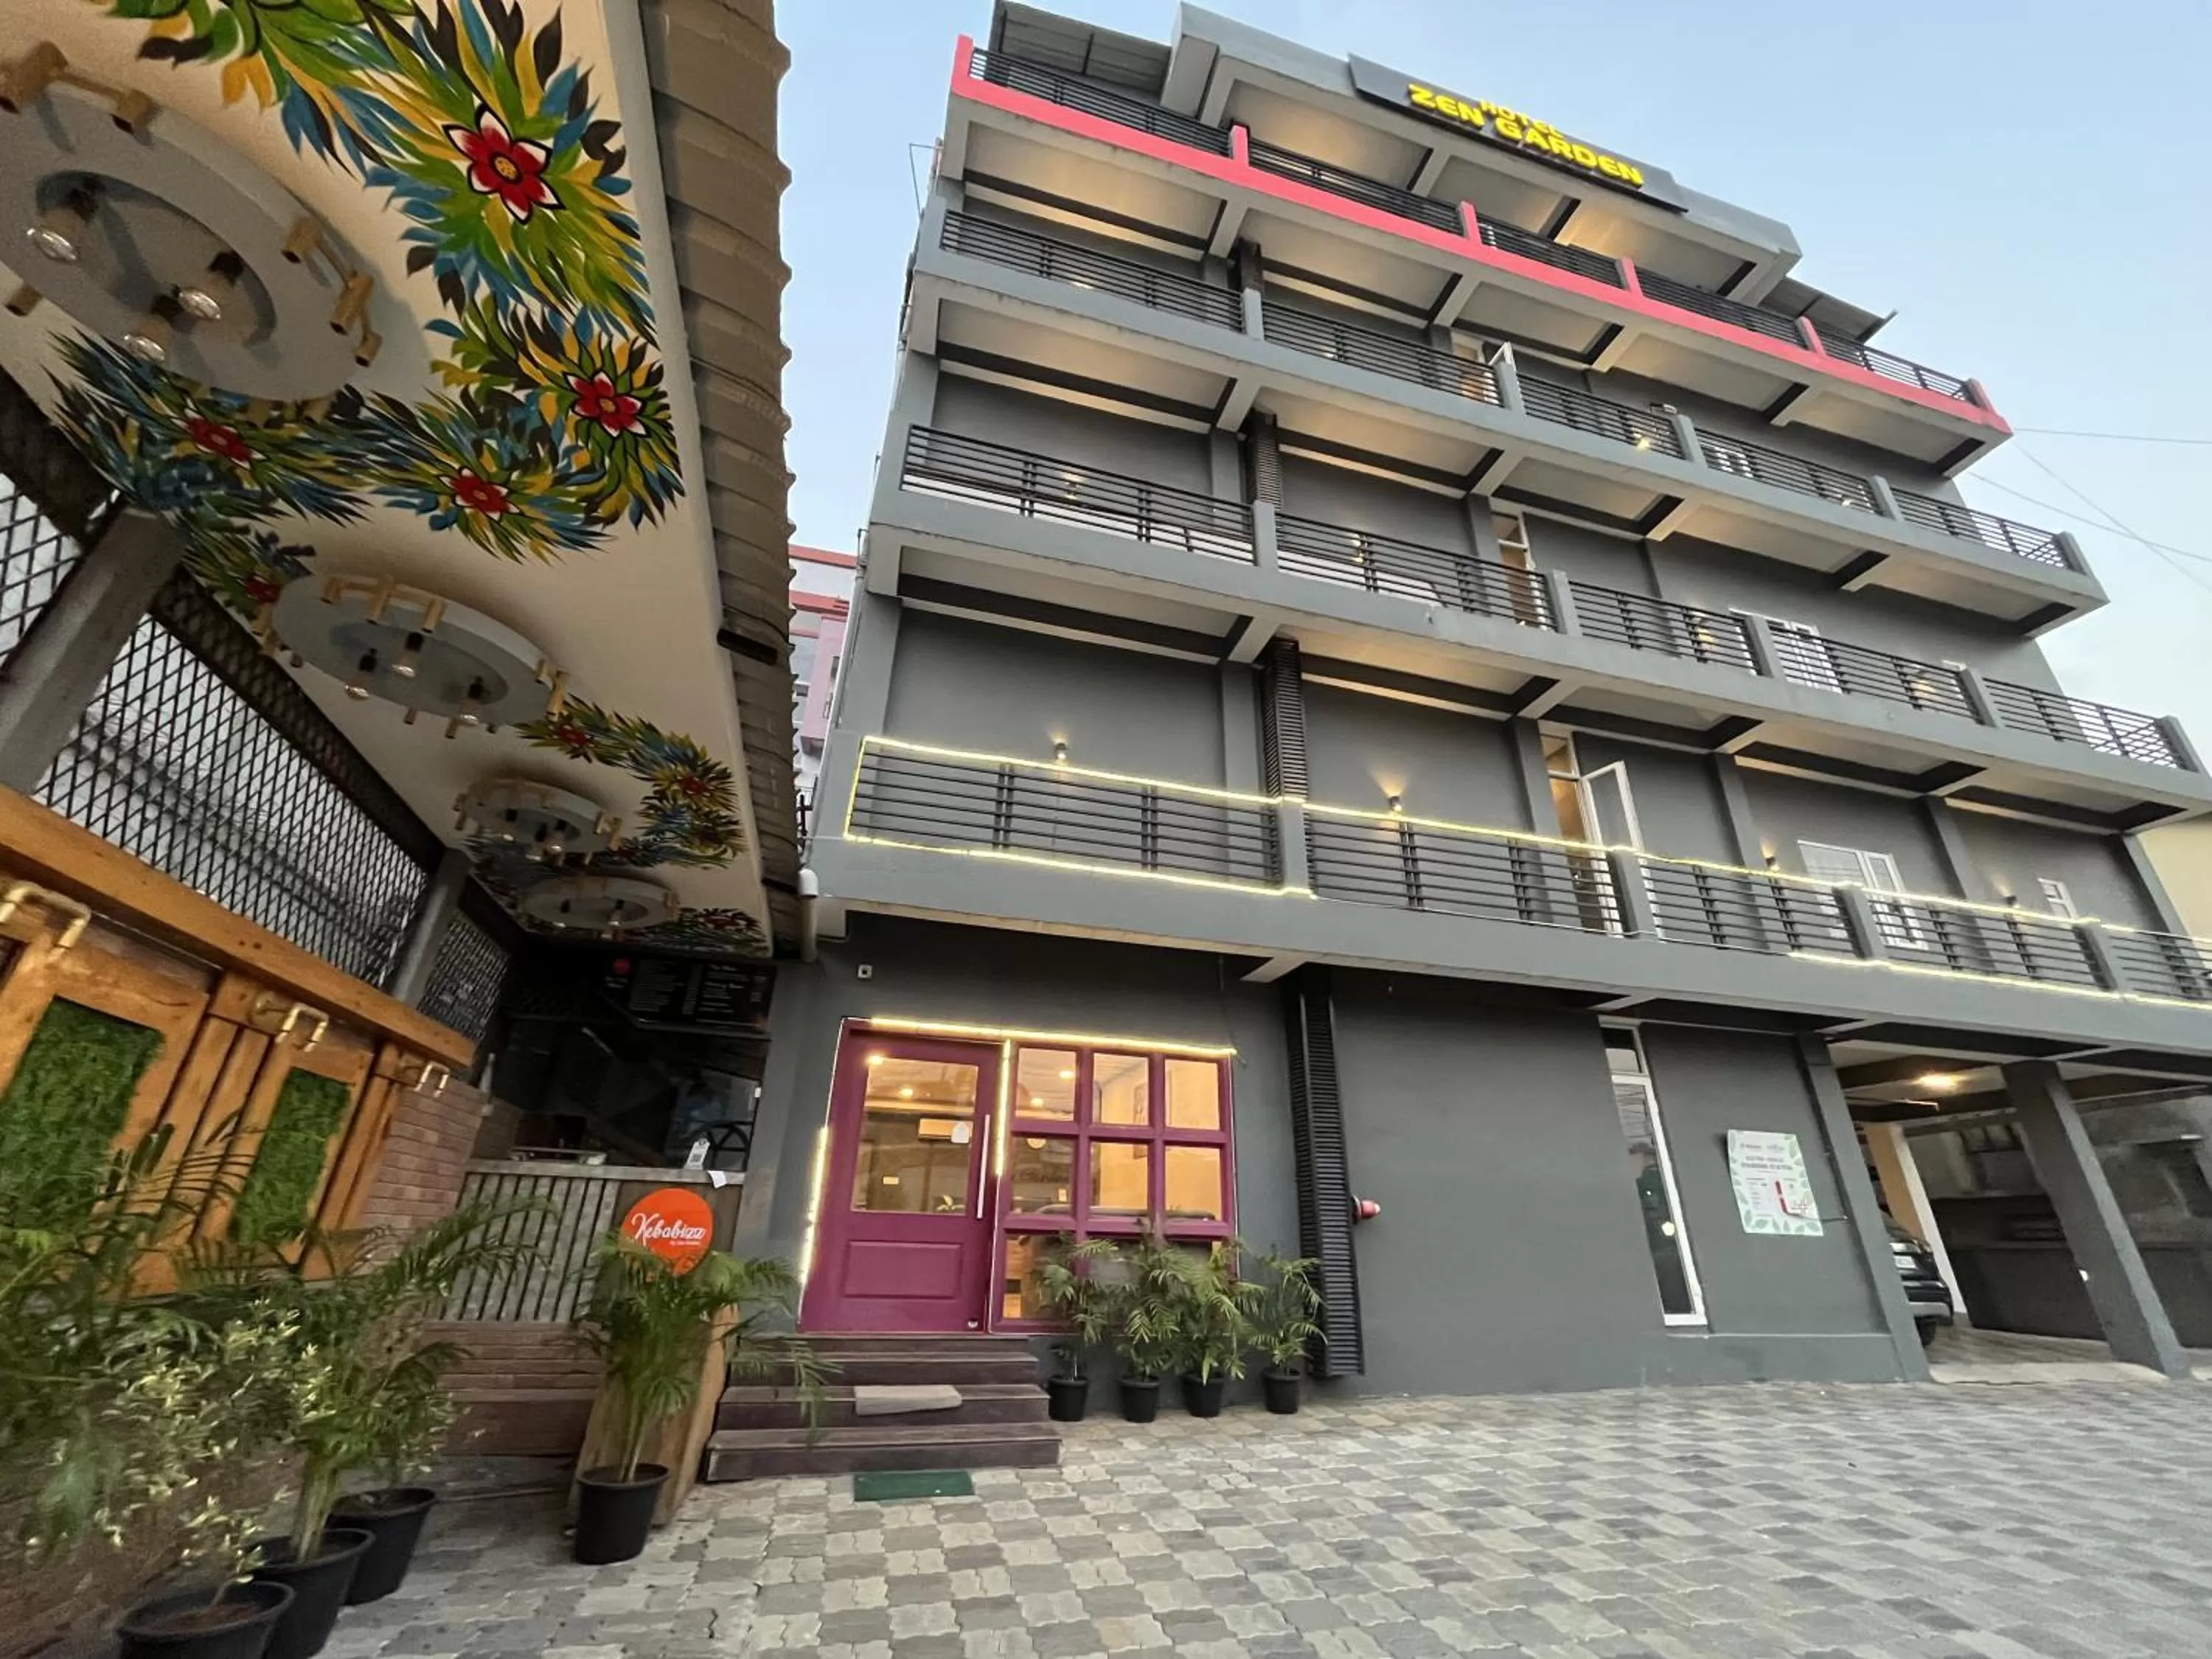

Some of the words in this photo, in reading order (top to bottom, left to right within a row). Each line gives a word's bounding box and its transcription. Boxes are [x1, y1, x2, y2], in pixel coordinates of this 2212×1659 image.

[1408, 83, 1485, 126] ZEN
[1495, 117, 1644, 185] GARDEN
[1479, 100, 1565, 138] HOTEL
